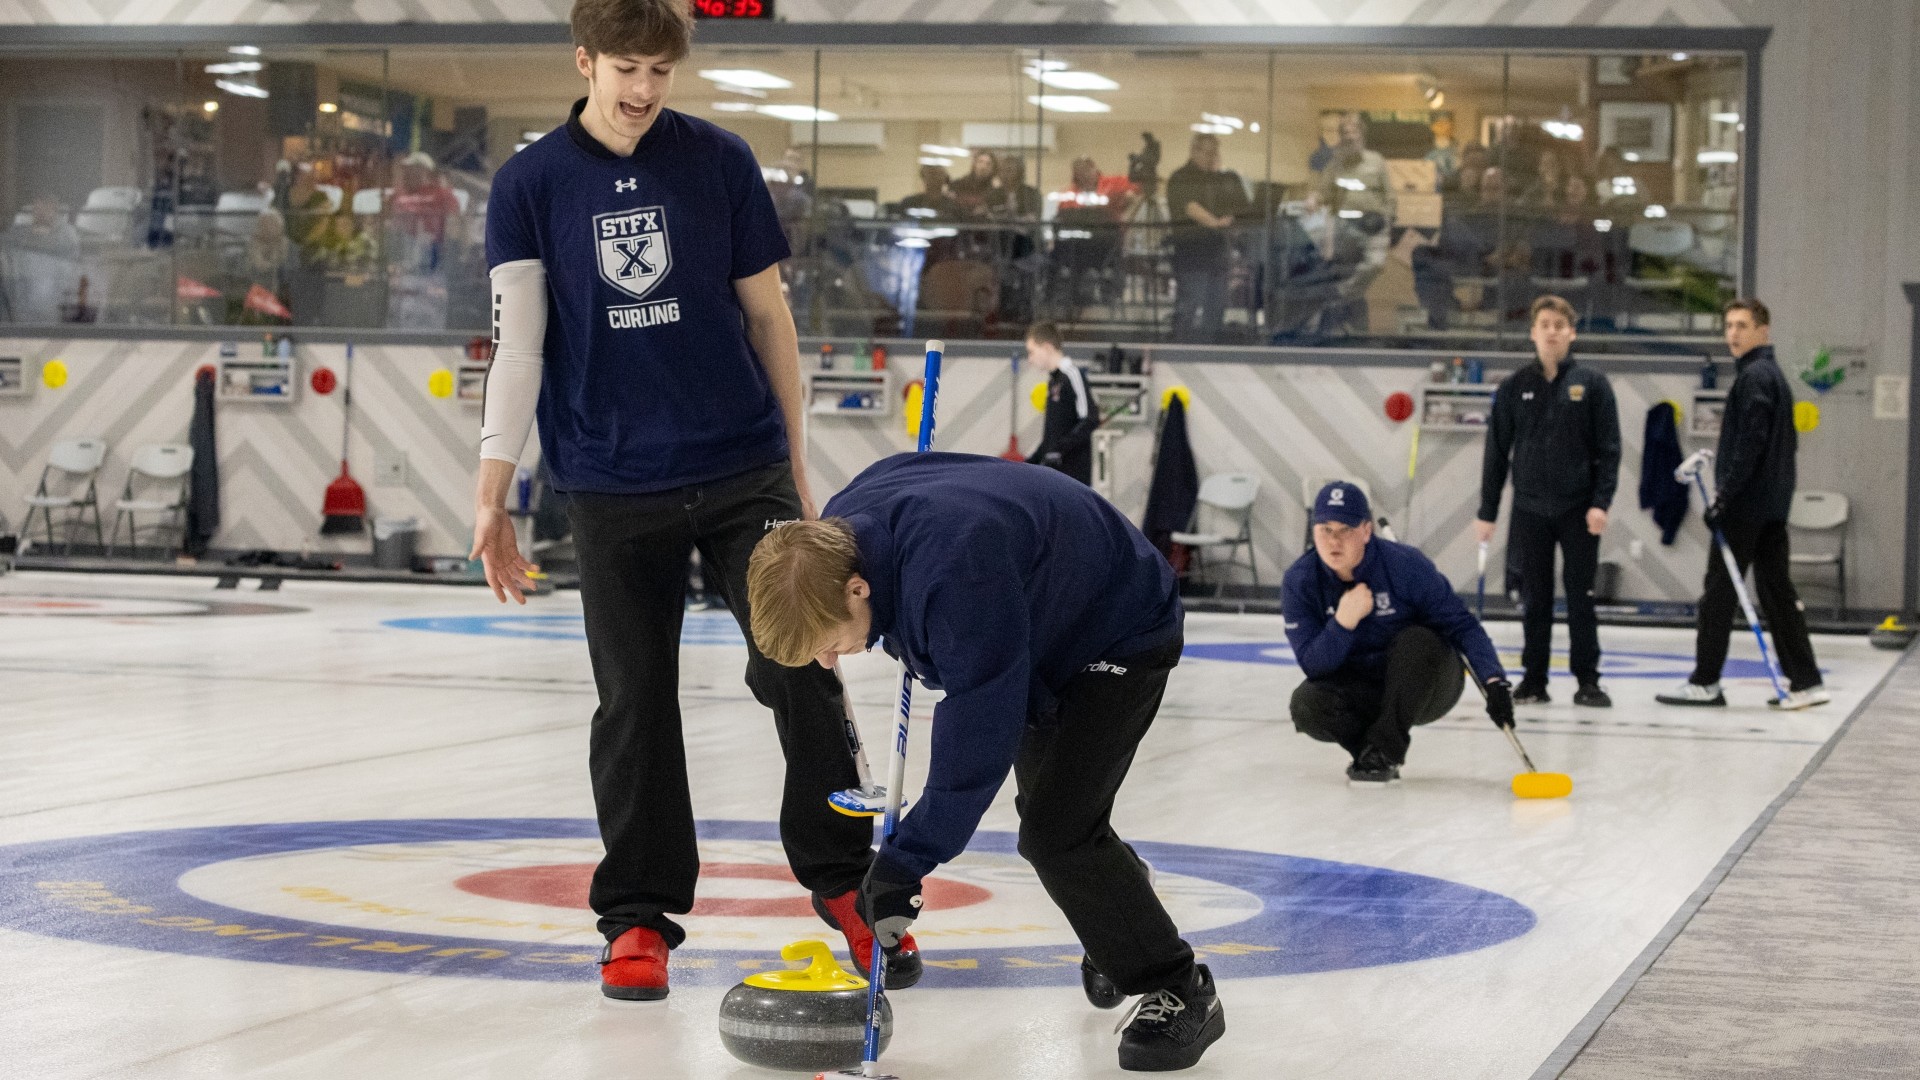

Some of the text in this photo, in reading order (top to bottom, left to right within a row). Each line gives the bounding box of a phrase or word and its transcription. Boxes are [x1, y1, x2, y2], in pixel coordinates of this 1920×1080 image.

[601, 212, 658, 238] STFX
[613, 236, 657, 281] X
[608, 302, 681, 329] CURLING
[139, 916, 596, 965] CURLING
